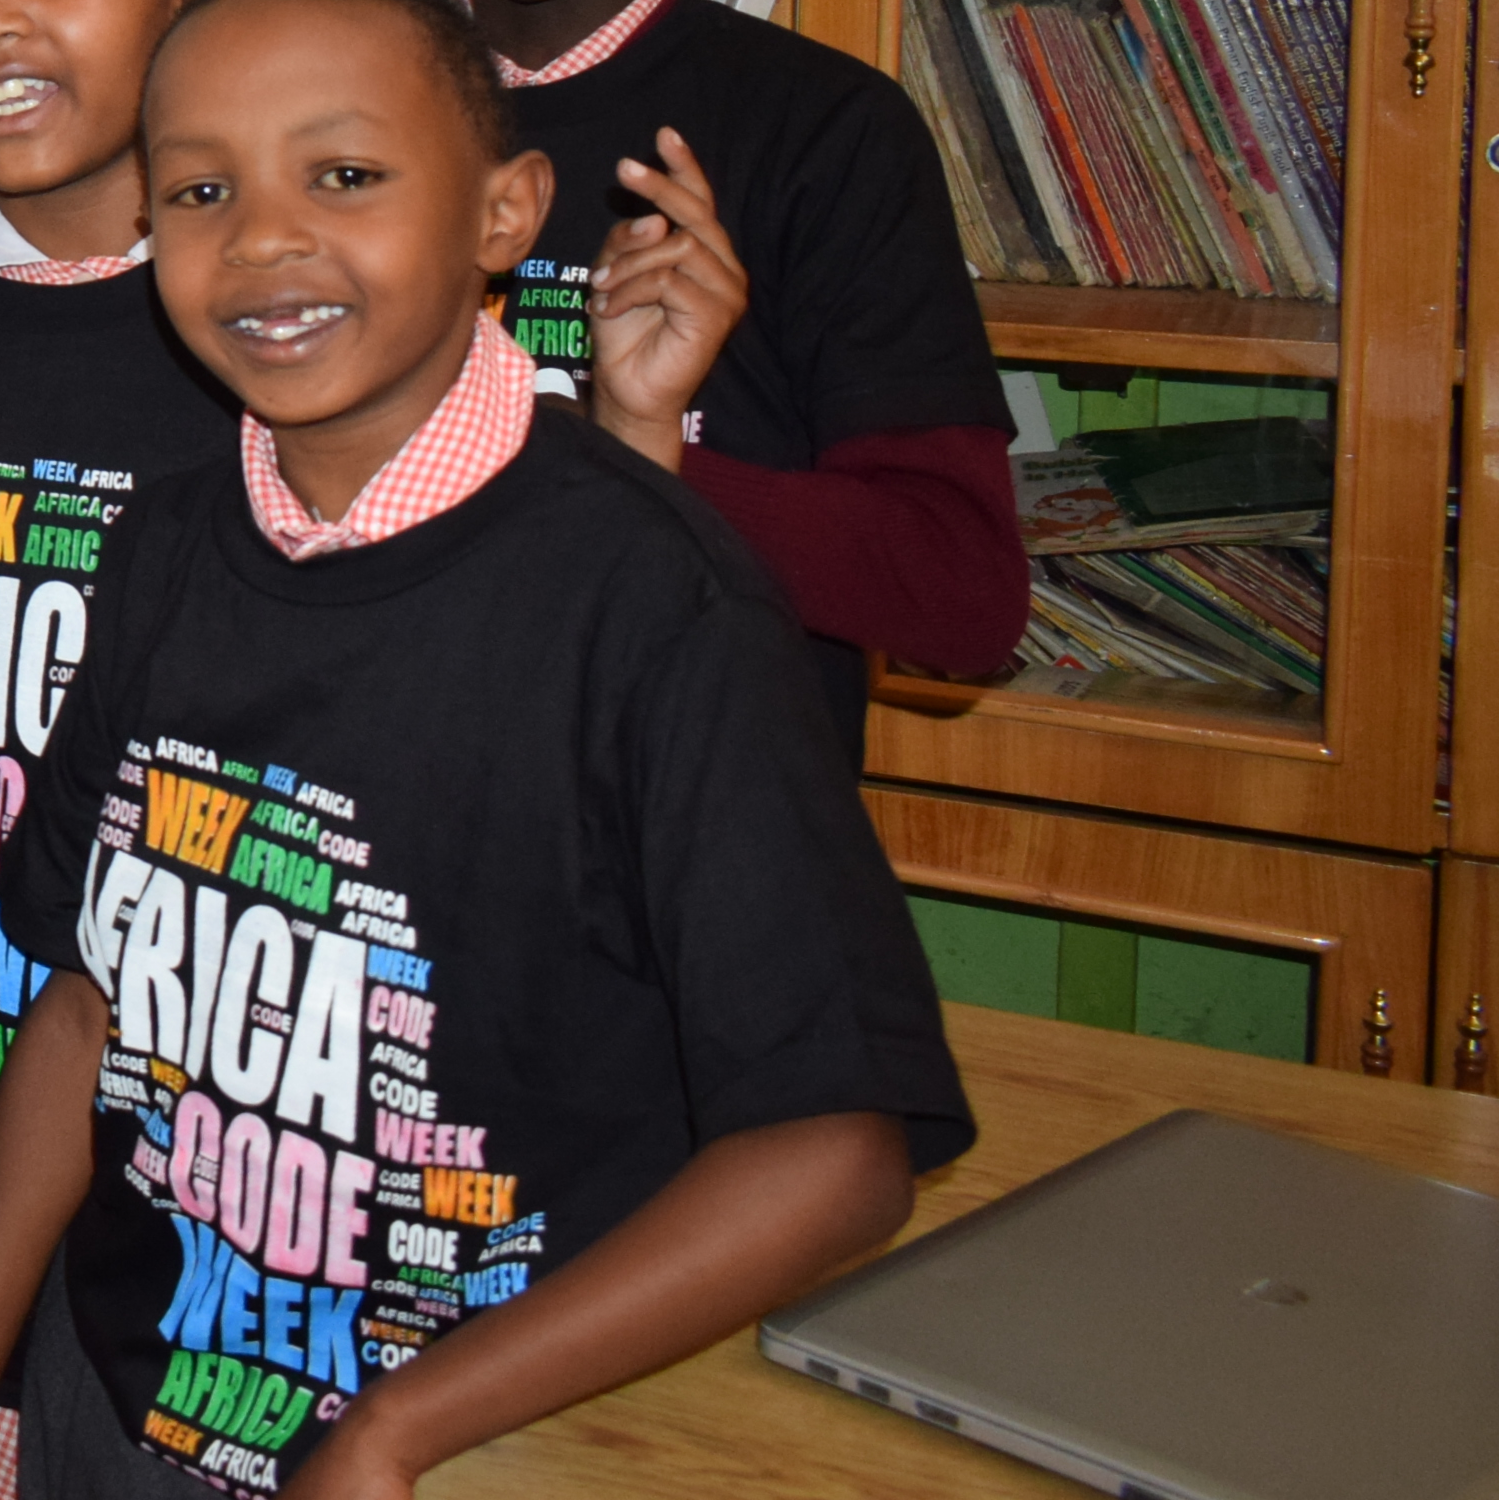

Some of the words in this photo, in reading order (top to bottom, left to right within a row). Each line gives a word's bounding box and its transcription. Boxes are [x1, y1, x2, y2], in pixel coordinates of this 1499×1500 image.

[519, 288, 582, 309] AFRICA
[145, 769, 249, 876] WEEK
[229, 833, 333, 914] AFRICA
[168, 1091, 376, 1288] CODE
[374, 1109, 487, 1169] WEEK
[159, 1214, 364, 1394] WEEK
[156, 1349, 315, 1452] AFRICA
